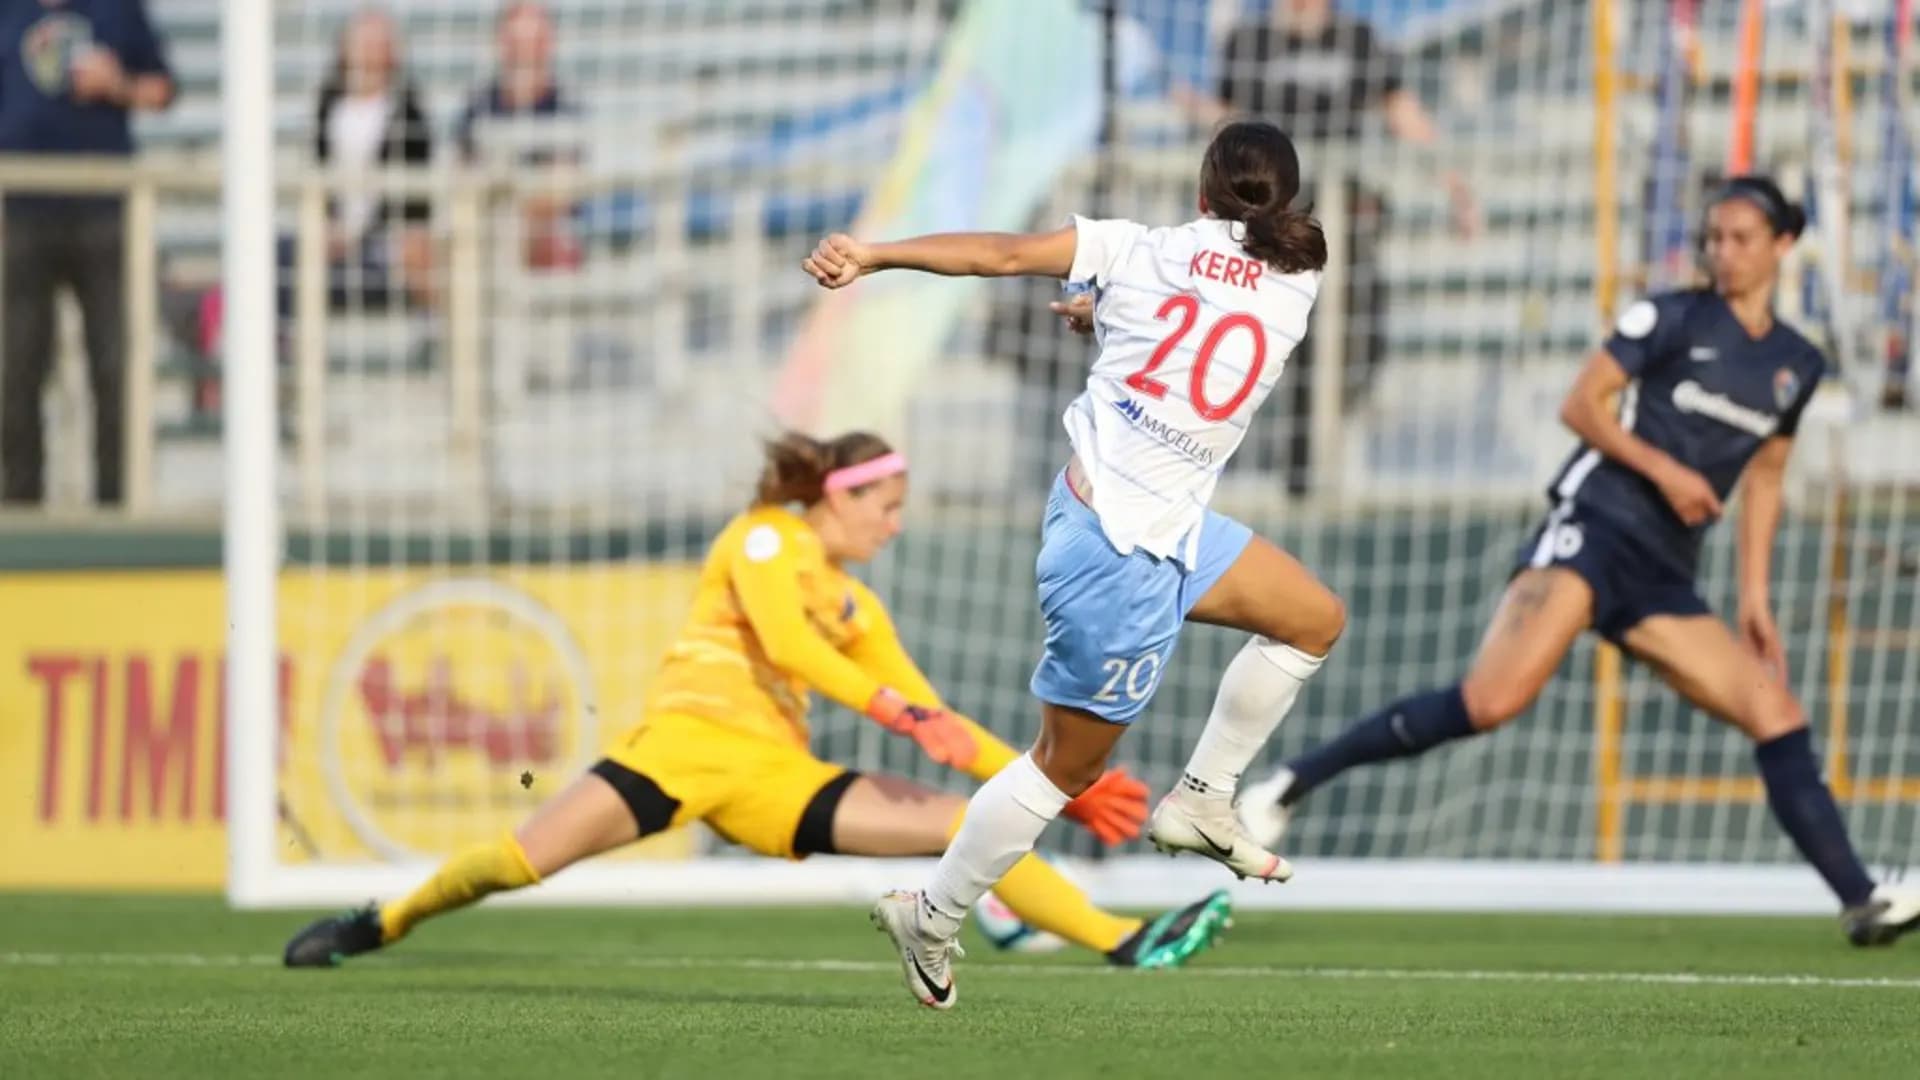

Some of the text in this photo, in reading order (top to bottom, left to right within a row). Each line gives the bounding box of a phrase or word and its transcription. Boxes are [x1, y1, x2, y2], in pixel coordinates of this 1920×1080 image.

[1188, 249, 1263, 291] KERR
[1124, 290, 1267, 422] 20
[1140, 414, 1213, 465] MAGELLAN
[1092, 652, 1160, 701] 20
